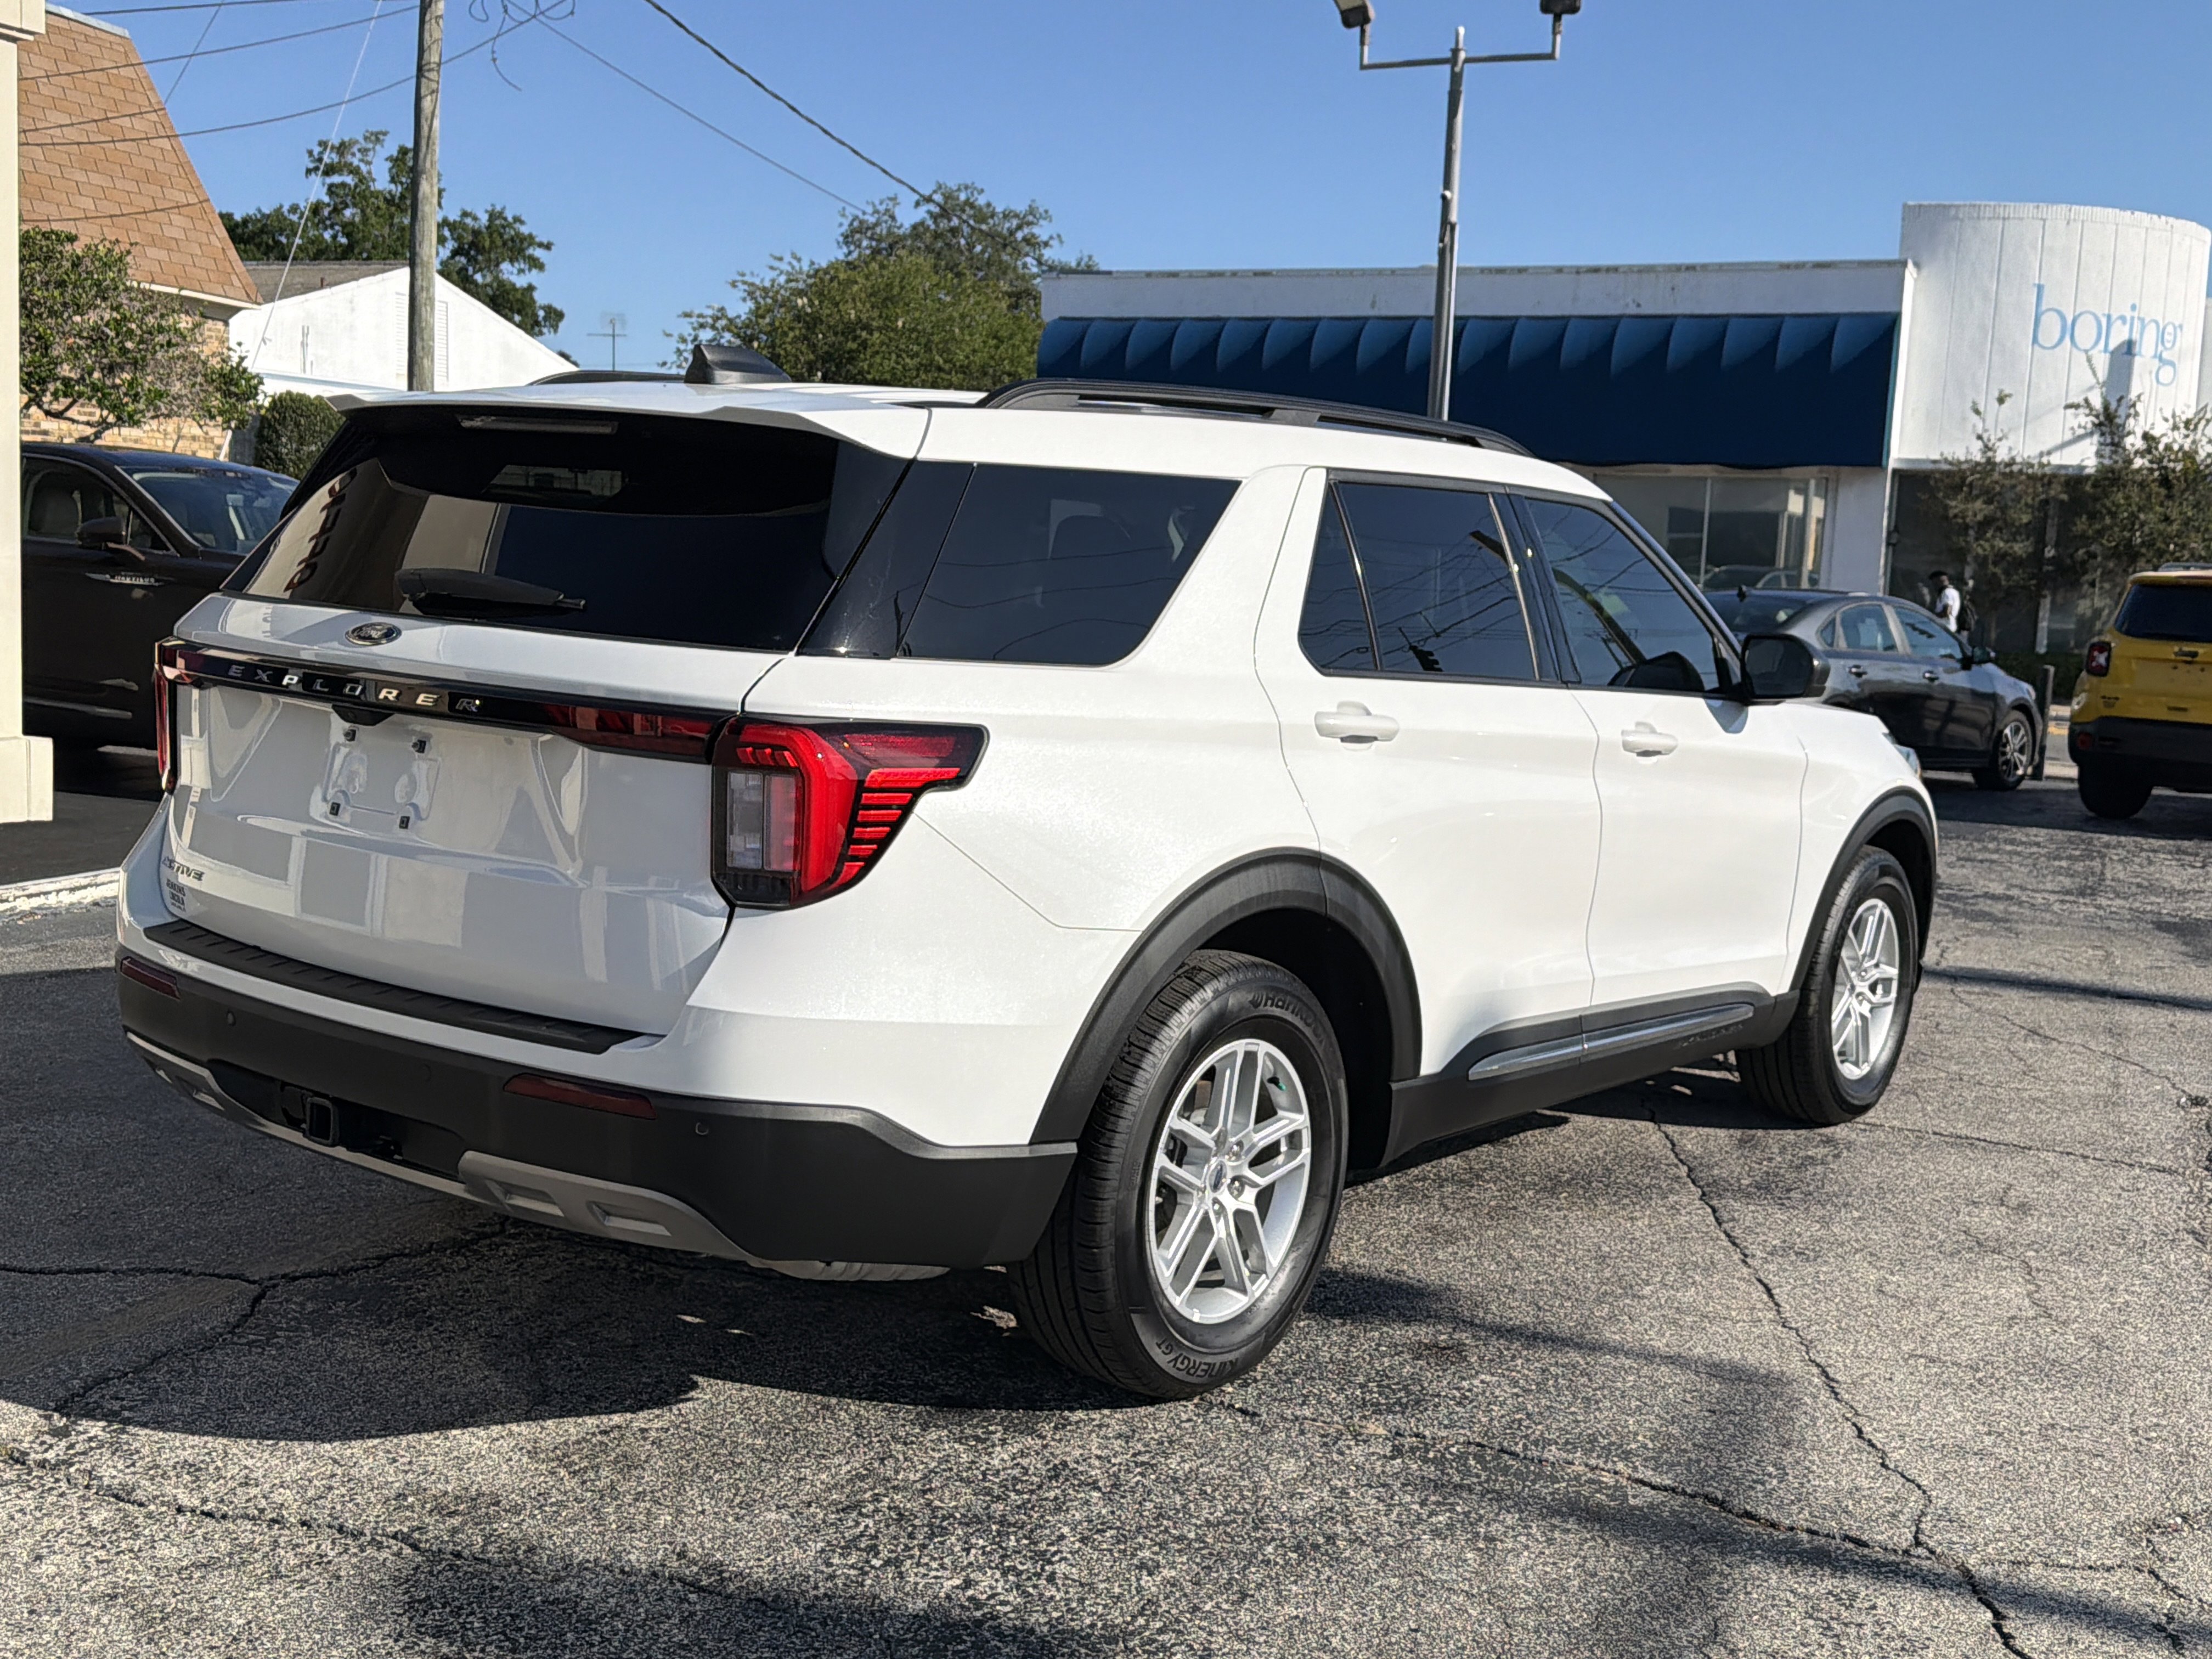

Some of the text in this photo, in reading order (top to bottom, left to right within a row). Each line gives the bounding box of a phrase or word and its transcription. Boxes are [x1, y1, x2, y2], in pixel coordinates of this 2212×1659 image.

[2032, 283, 2183, 386] boring
[227, 664, 482, 713] EXPLORER
[161, 856, 206, 882] ACTIVE
[1155, 1338, 1174, 1356] GT
